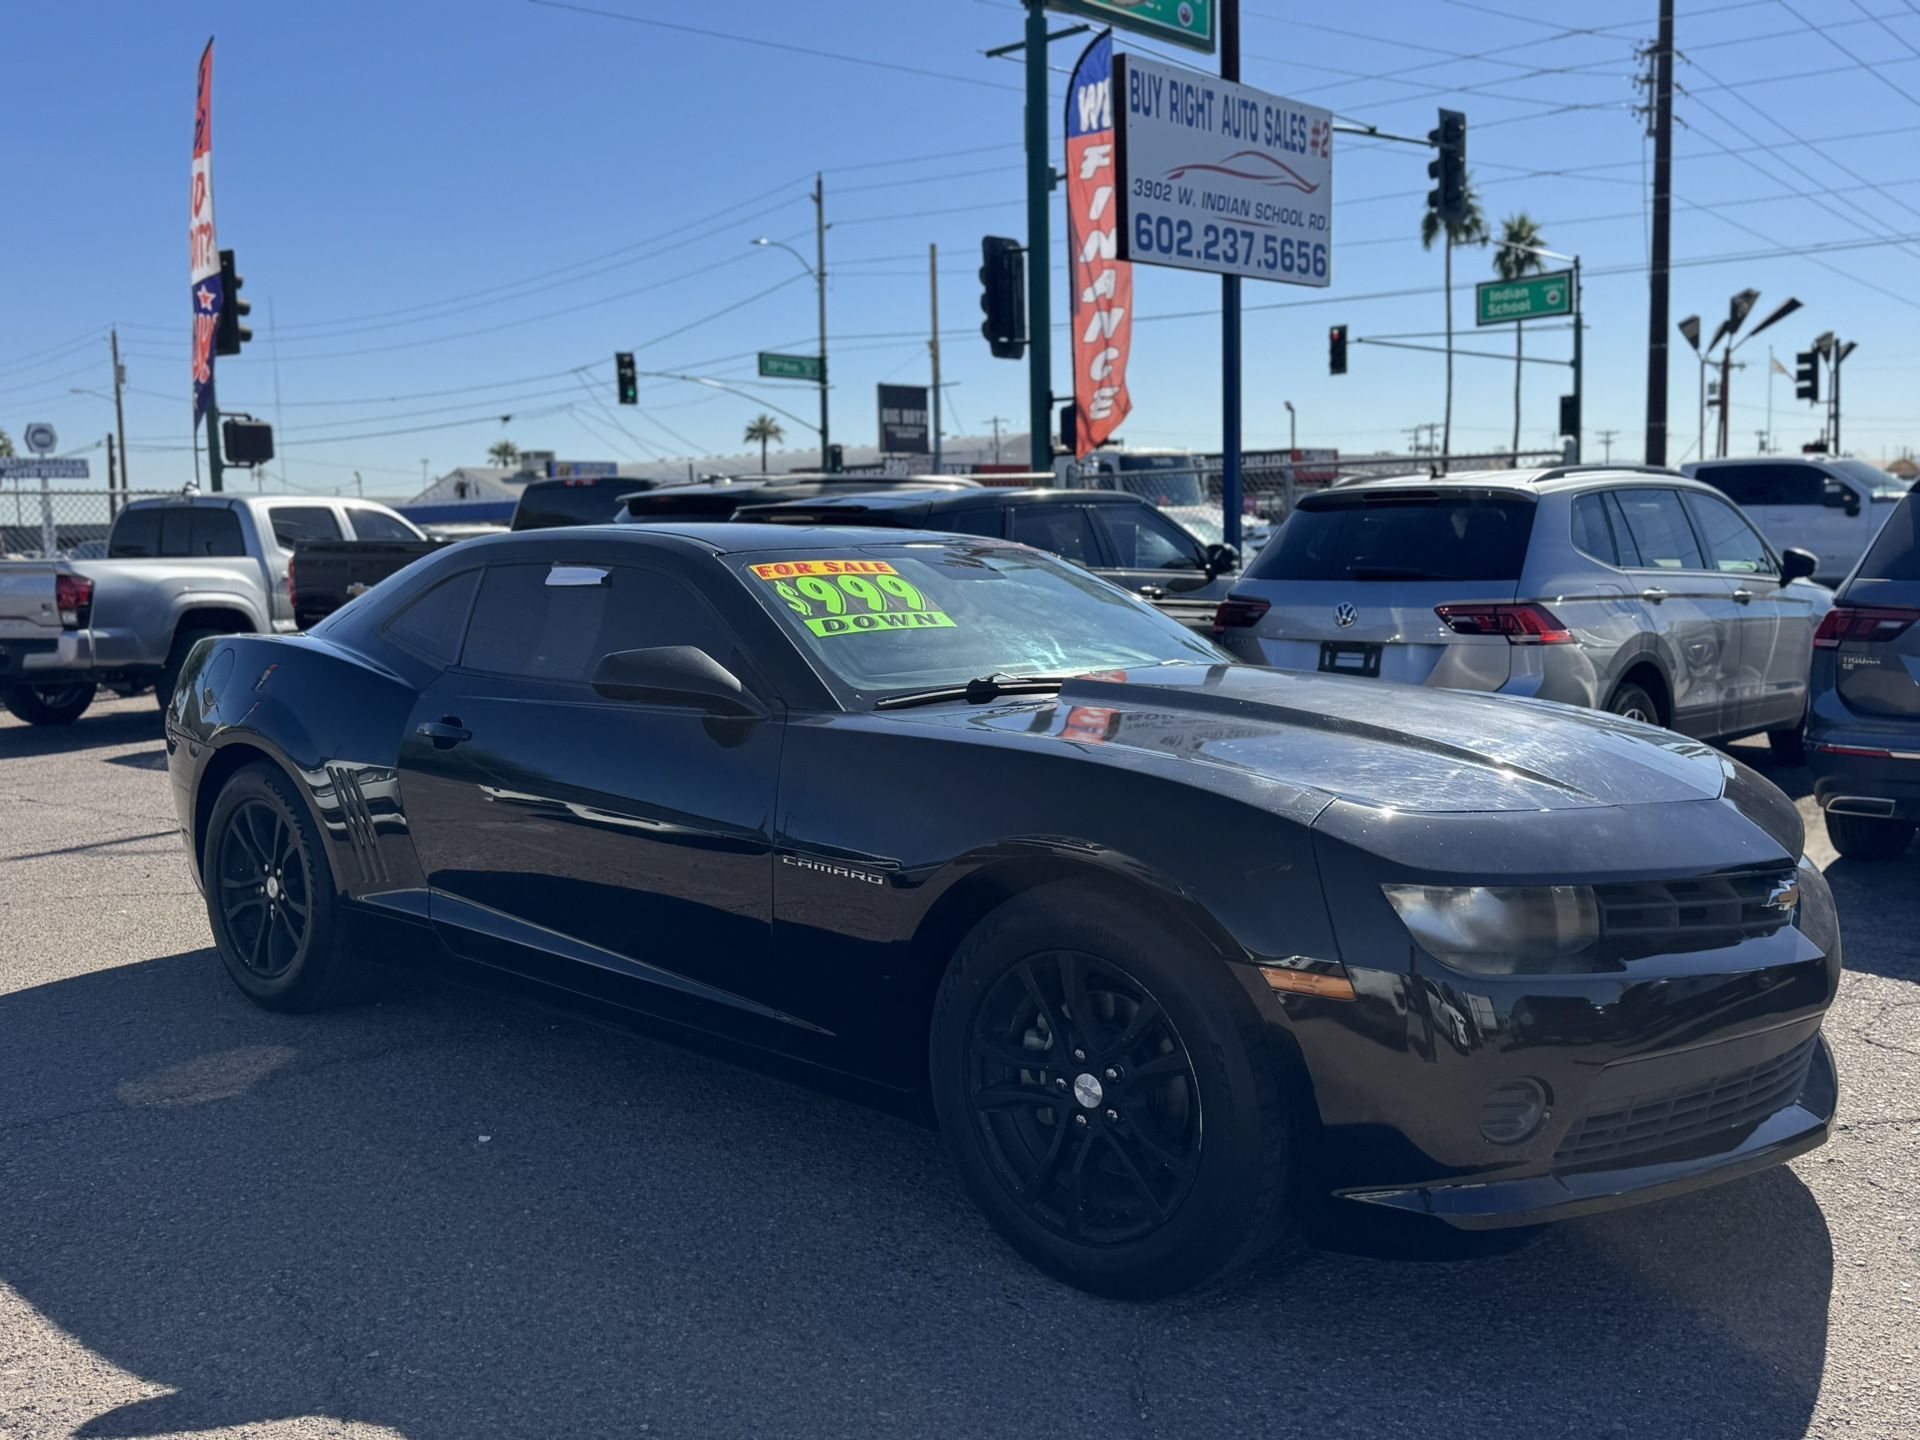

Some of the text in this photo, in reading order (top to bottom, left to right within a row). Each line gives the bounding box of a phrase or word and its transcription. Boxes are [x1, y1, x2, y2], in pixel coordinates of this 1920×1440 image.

[1130, 69, 1330, 159] BUY RIGHT AUTO SALES #2
[1134, 178, 1172, 202] 3902
[1178, 187, 1196, 207] W.
[1202, 192, 1250, 217] INDIAN
[1255, 203, 1304, 228] SCHOOL
[1135, 212, 1327, 278] 602.237.5656
[1079, 144, 1125, 420] FINANCE
[1489, 288, 1529, 302] Indian
[1488, 299, 1532, 316] School
[4, 467, 88, 478] AUTO REPAIR
[756, 561, 891, 577] FOR SALE
[775, 575, 926, 616] $999
[821, 613, 940, 633] DOWN
[783, 854, 884, 885] CAMARO
